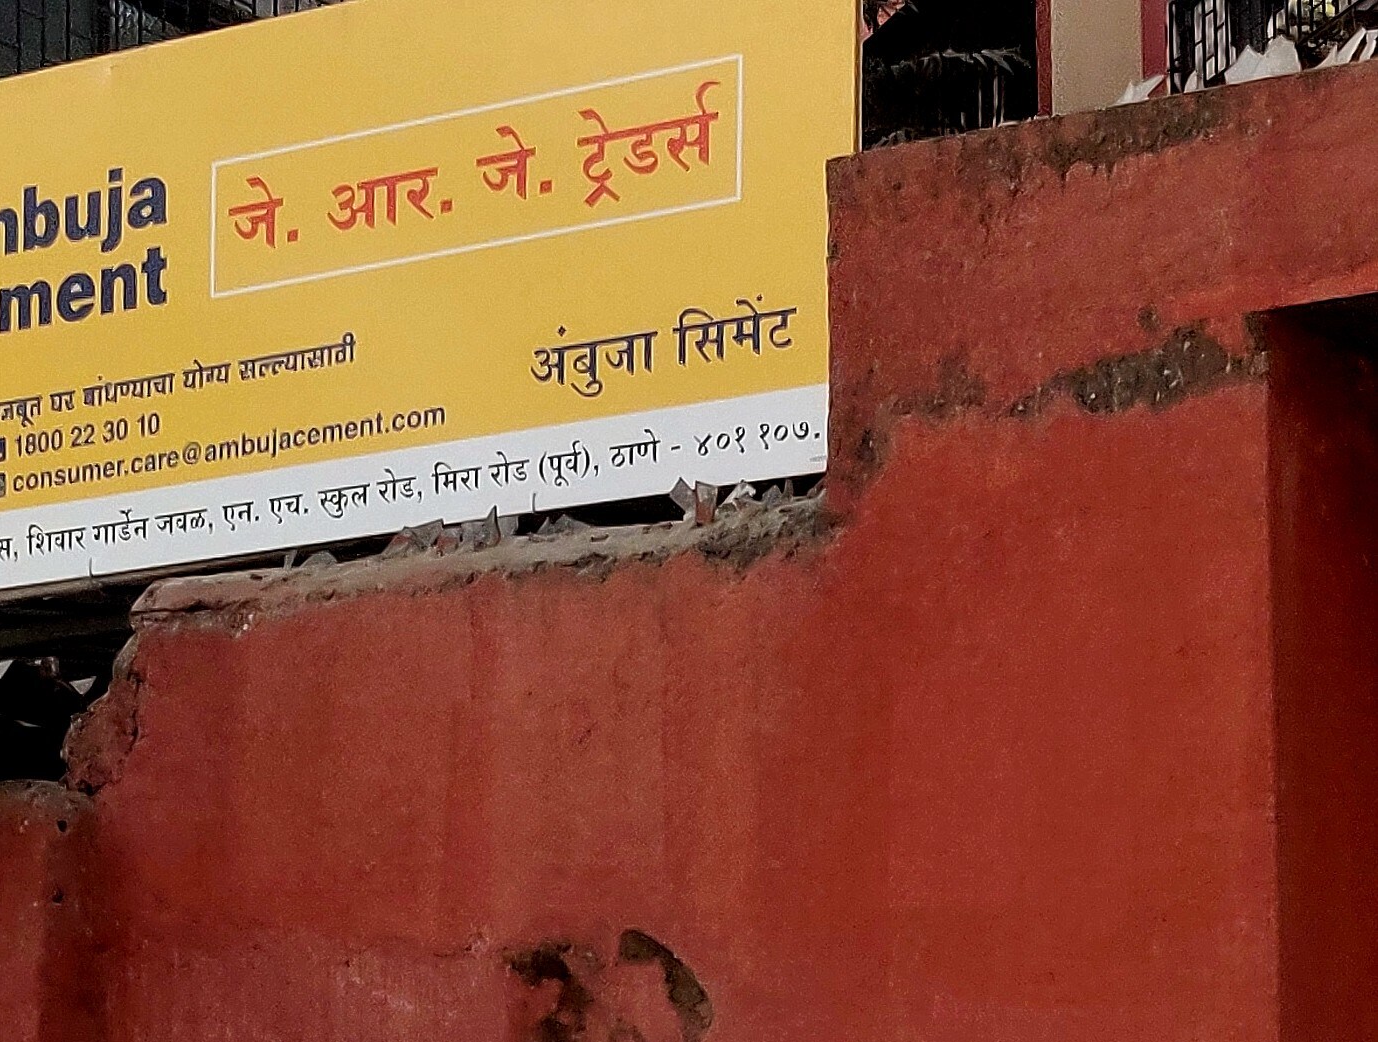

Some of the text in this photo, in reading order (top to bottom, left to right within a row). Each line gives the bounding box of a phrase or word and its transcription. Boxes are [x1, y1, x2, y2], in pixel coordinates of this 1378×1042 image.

[228, 80, 720, 249] जे. आर. जे. ट्रेडर्स
[183, 360, 231, 390] योग्य
[530, 293, 798, 397] अंबुजा सिमेंट
[11, 405, 447, 493] consumer.care@ambujacement.com
[15, 411, 162, 458] 1800 22 30 10
[26, 524, 87, 557] शिवार
[155, 507, 214, 535] जवळ,
[222, 500, 261, 526] एन.
[269, 493, 310, 519] एच.
[317, 480, 371, 521] स्कुल
[377, 466, 424, 502] रोड,
[431, 460, 483, 495] मिरा
[490, 451, 529, 486] रोड
[538, 439, 601, 486] (पूर्व),
[609, 428, 662, 467] ठाणे
[694, 425, 748, 457] ४०१
